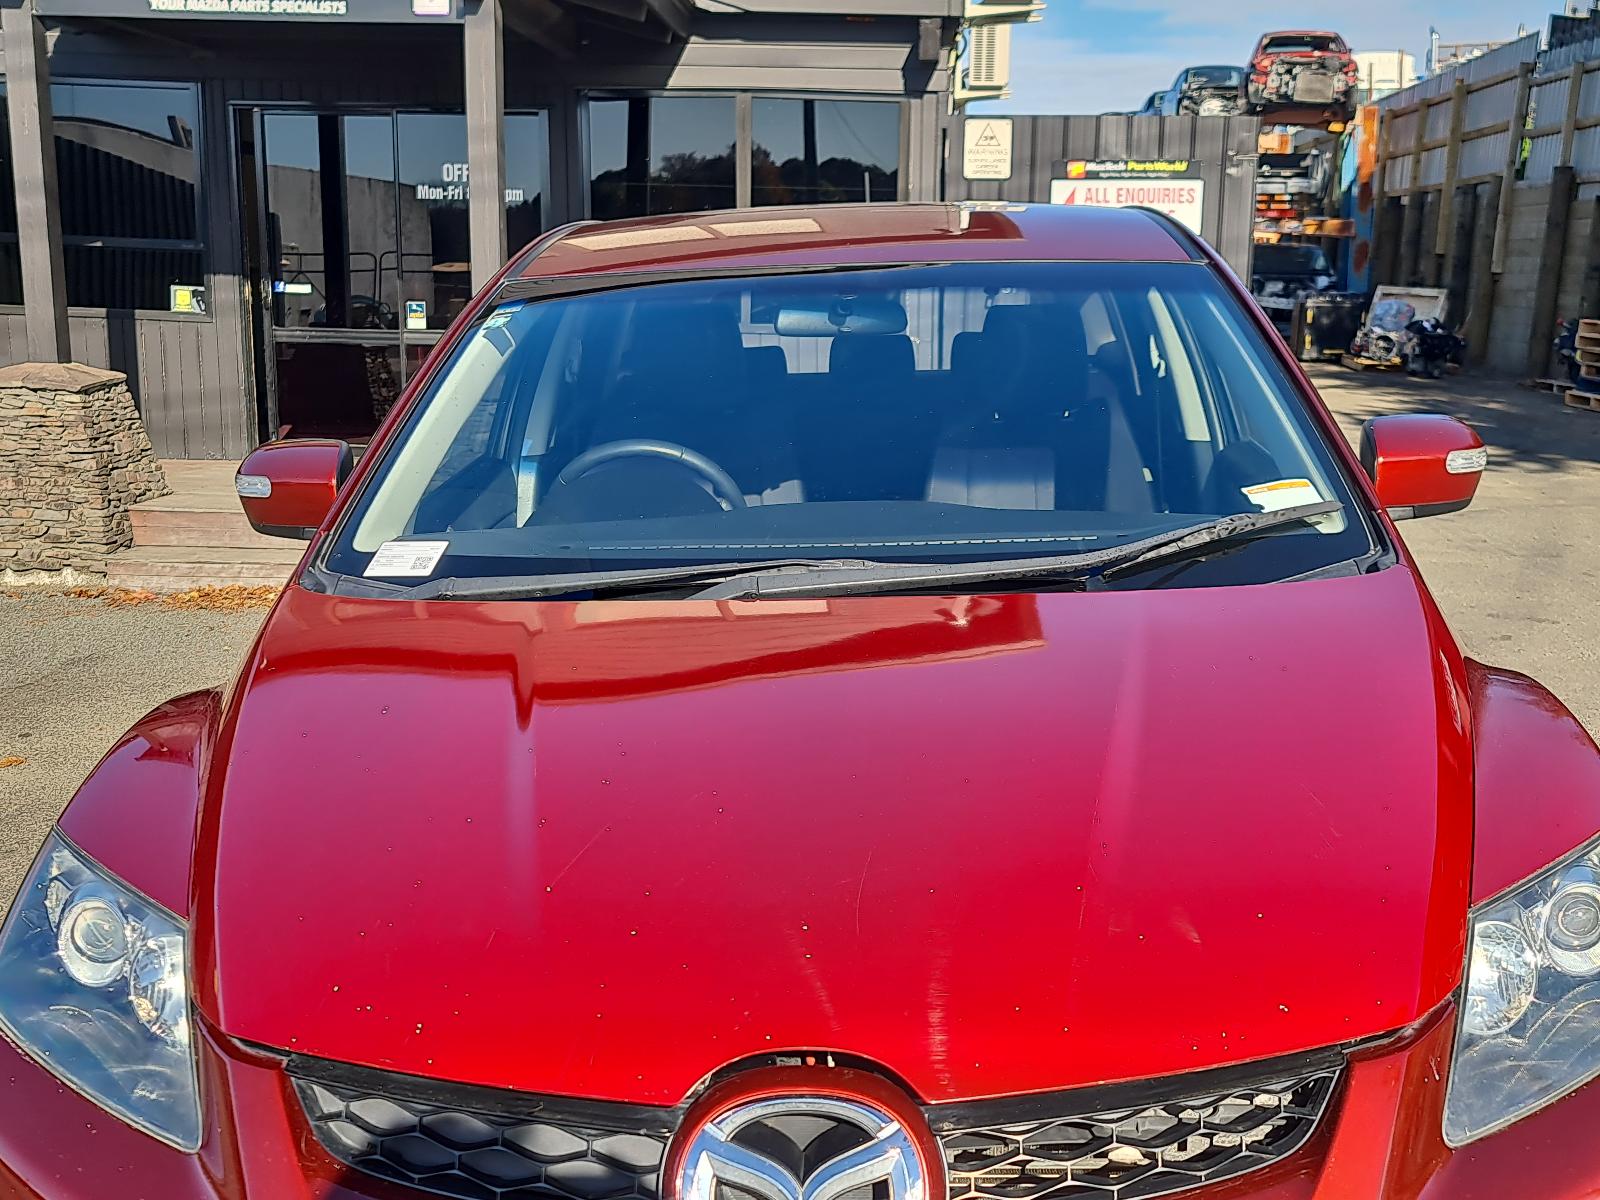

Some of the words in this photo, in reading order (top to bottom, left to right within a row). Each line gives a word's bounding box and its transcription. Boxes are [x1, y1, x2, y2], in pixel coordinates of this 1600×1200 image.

[148, 0, 185, 10] YOUR
[186, 0, 229, 12] MAZDA
[230, 0, 269, 13] PARTS
[270, 0, 347, 14] SPECIALISTS
[442, 163, 469, 181] OFF
[417, 184, 463, 200] Mon-Fri
[1085, 187, 1110, 203] ALL
[1116, 187, 1196, 204] ENQUIRIES
